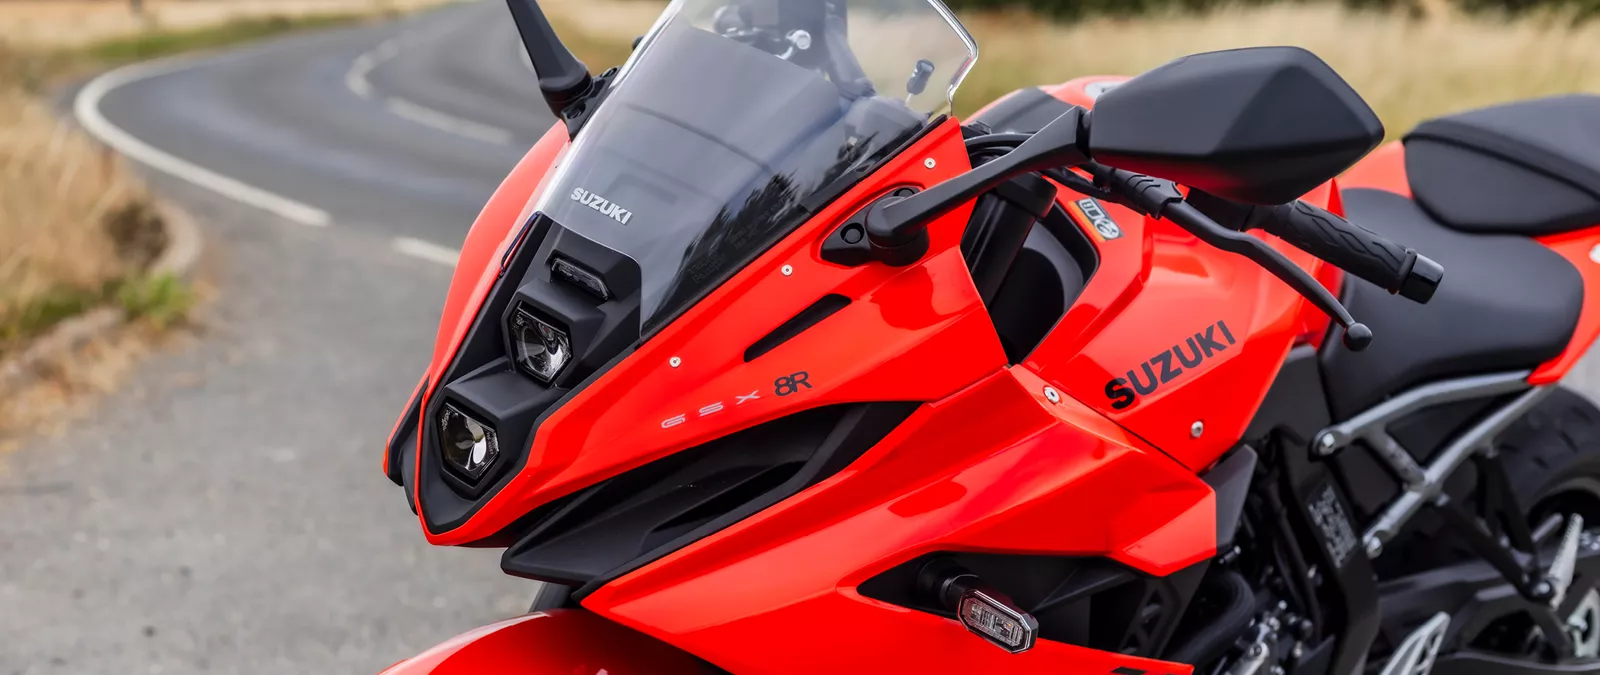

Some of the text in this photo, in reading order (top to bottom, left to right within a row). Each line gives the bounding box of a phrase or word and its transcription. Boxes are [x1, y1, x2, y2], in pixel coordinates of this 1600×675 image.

[570, 187, 633, 225] SUZUKI
[773, 370, 813, 397] 8R
[1104, 319, 1236, 411] SUZUKI
